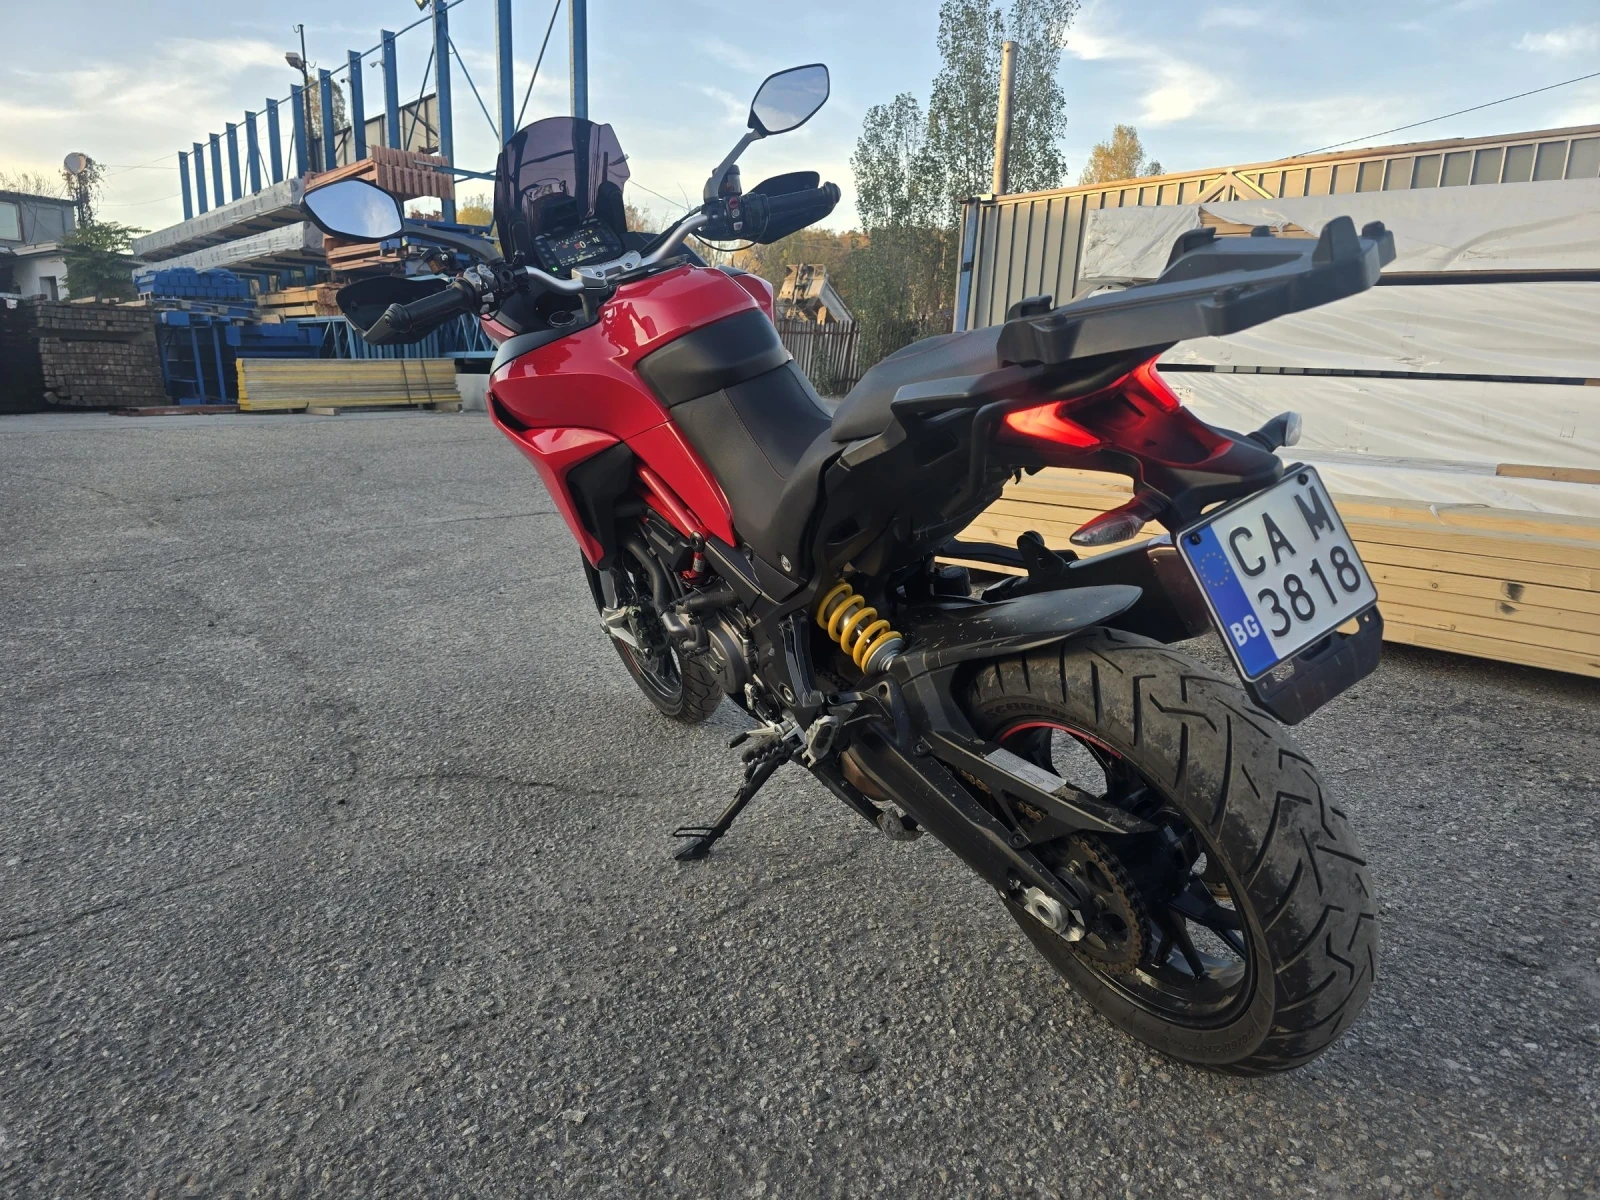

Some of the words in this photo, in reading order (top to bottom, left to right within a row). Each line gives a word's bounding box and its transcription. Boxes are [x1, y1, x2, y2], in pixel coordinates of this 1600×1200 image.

[1229, 512, 1296, 577] CA
[1293, 485, 1336, 541] M
[1230, 614, 1260, 647] BG
[1257, 545, 1361, 637] 3818
